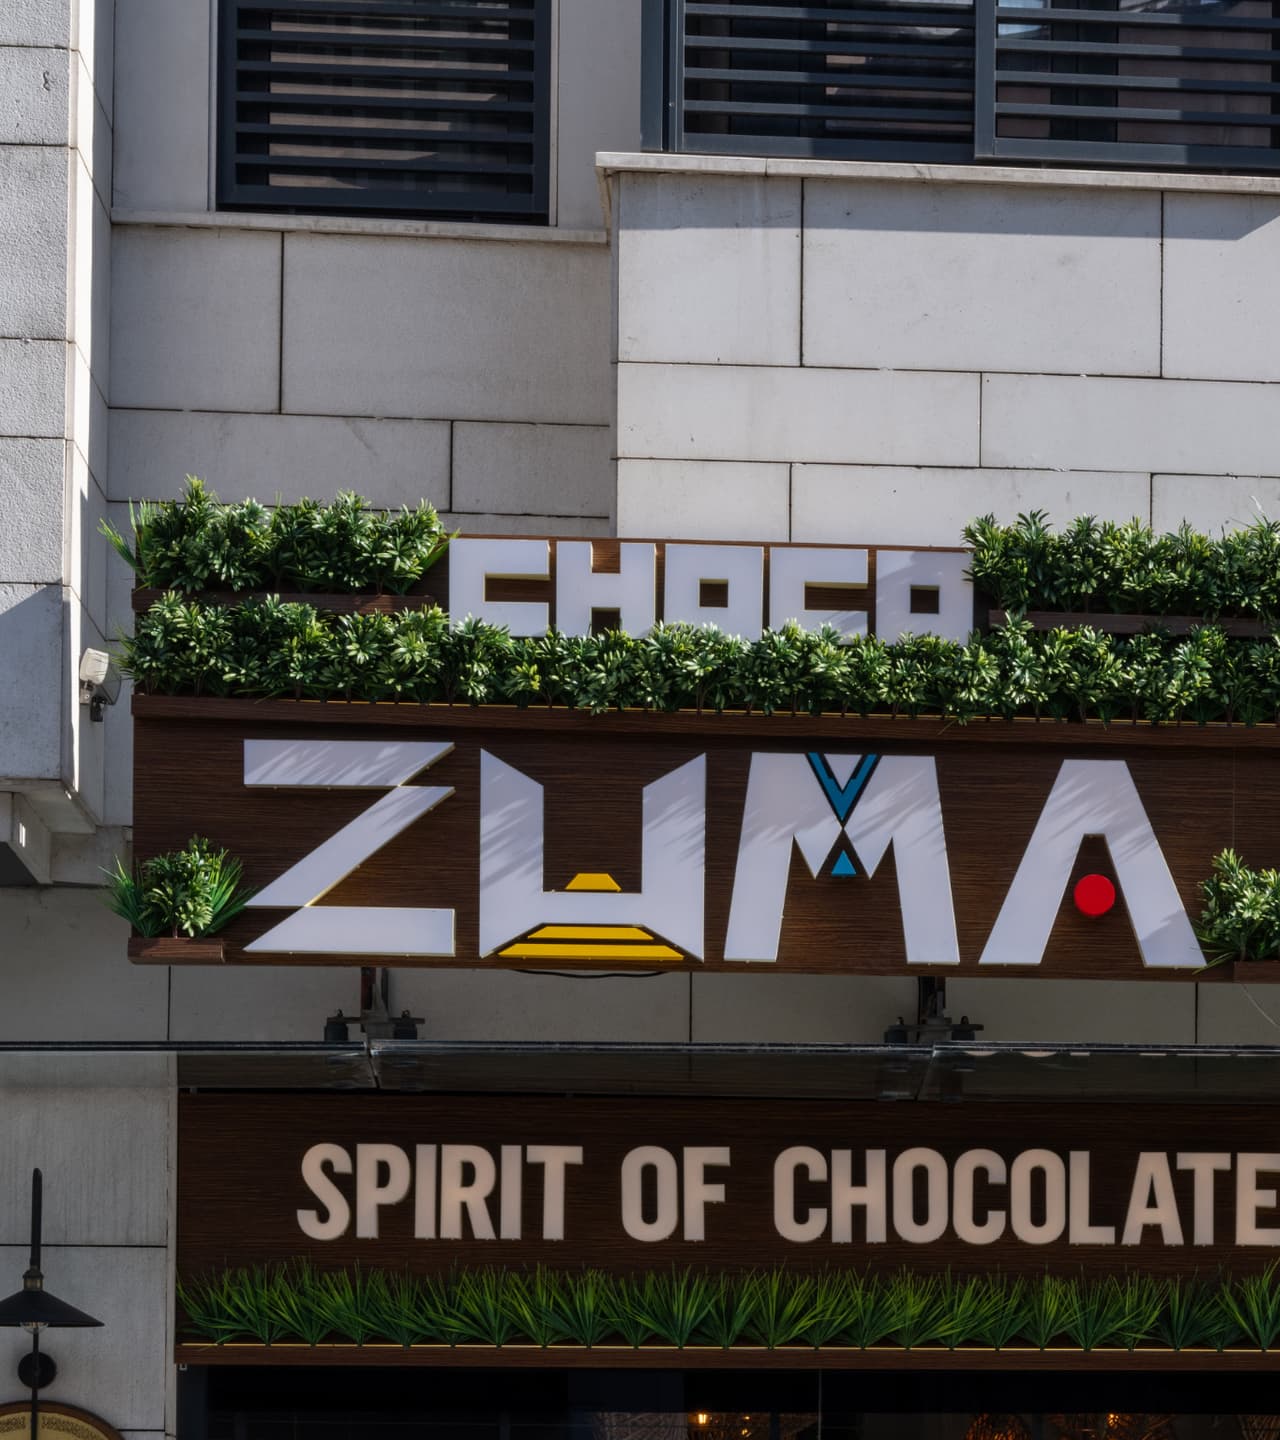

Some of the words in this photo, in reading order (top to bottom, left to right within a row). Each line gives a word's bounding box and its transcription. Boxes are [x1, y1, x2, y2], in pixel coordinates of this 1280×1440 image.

[449, 538, 973, 645] CHOCO
[244, 739, 1206, 968] ZUMA
[296, 1143, 584, 1241] SPIRIT
[620, 1145, 731, 1243] OF
